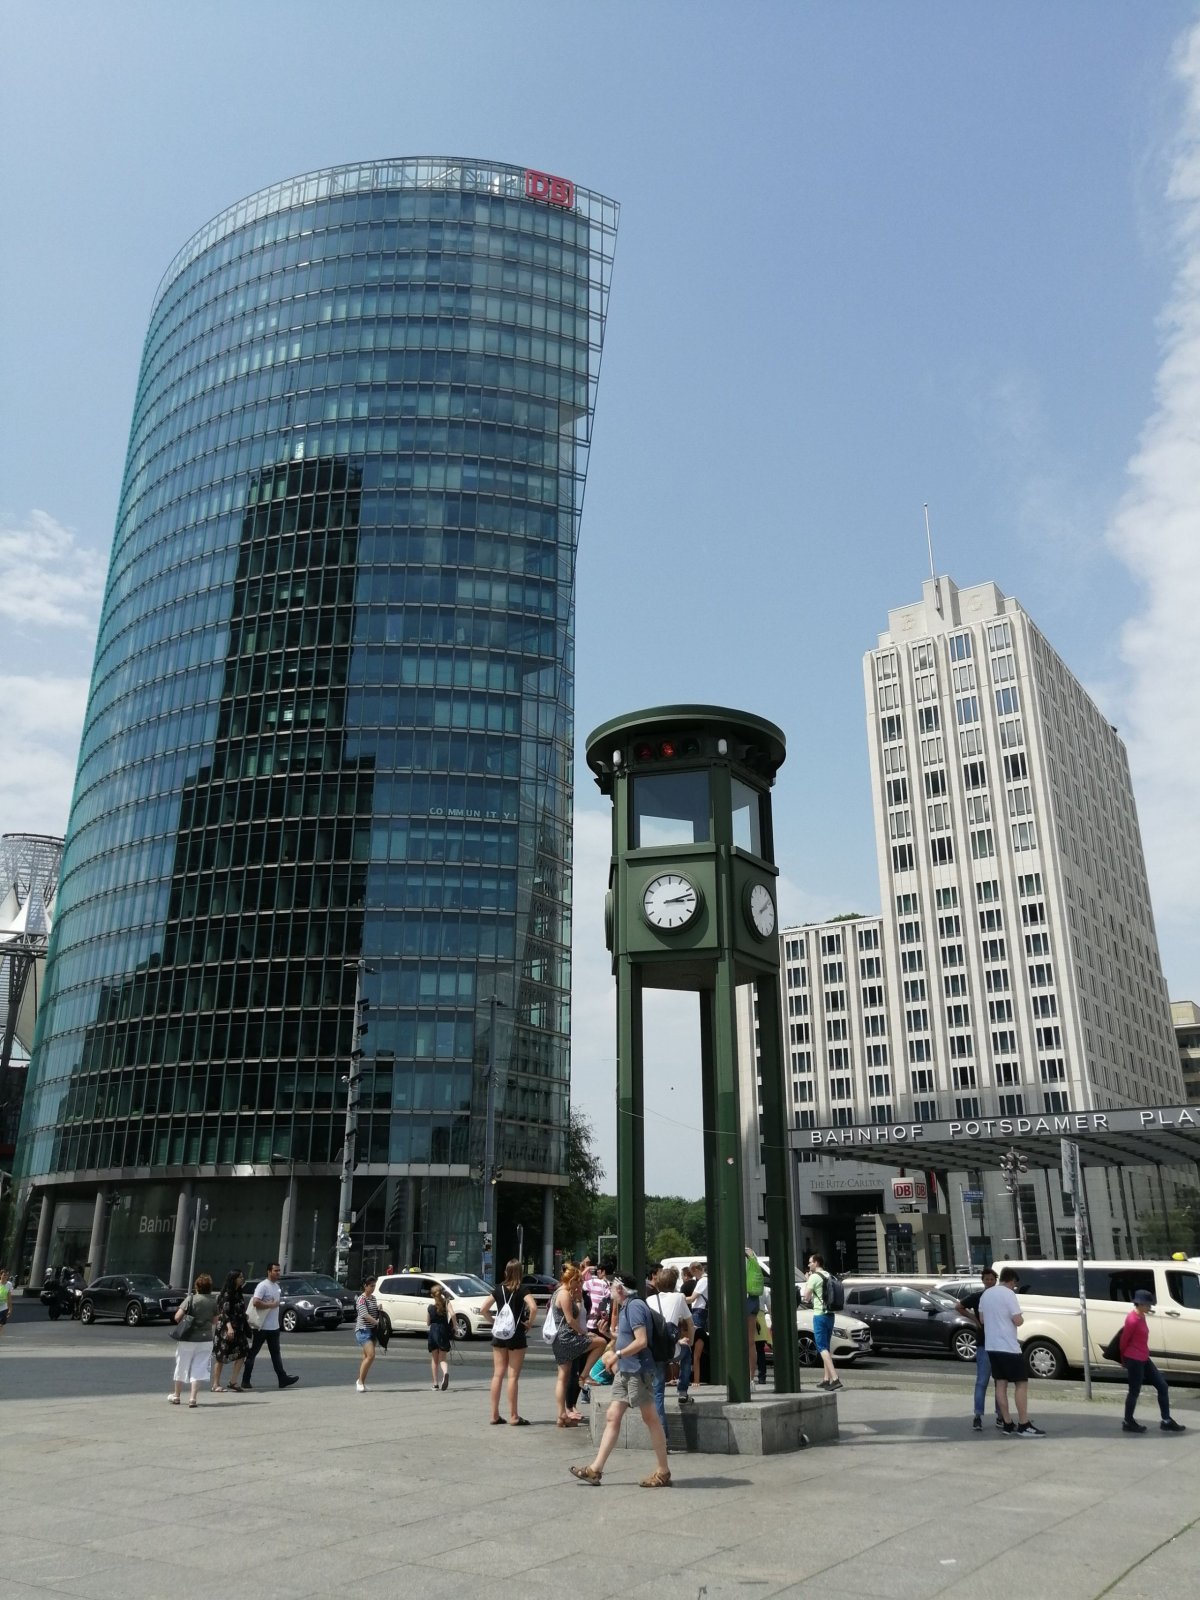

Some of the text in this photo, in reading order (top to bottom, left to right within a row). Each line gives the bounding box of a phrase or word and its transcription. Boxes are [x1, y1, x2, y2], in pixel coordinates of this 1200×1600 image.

[530, 173, 569, 204] DB
[811, 1125, 923, 1143] BAHNHOF
[949, 1114, 1108, 1136] POTSDAMER
[810, 1180, 825, 1189] THE
[916, 1185, 926, 1196] DB
[896, 1185, 912, 1197] DB
